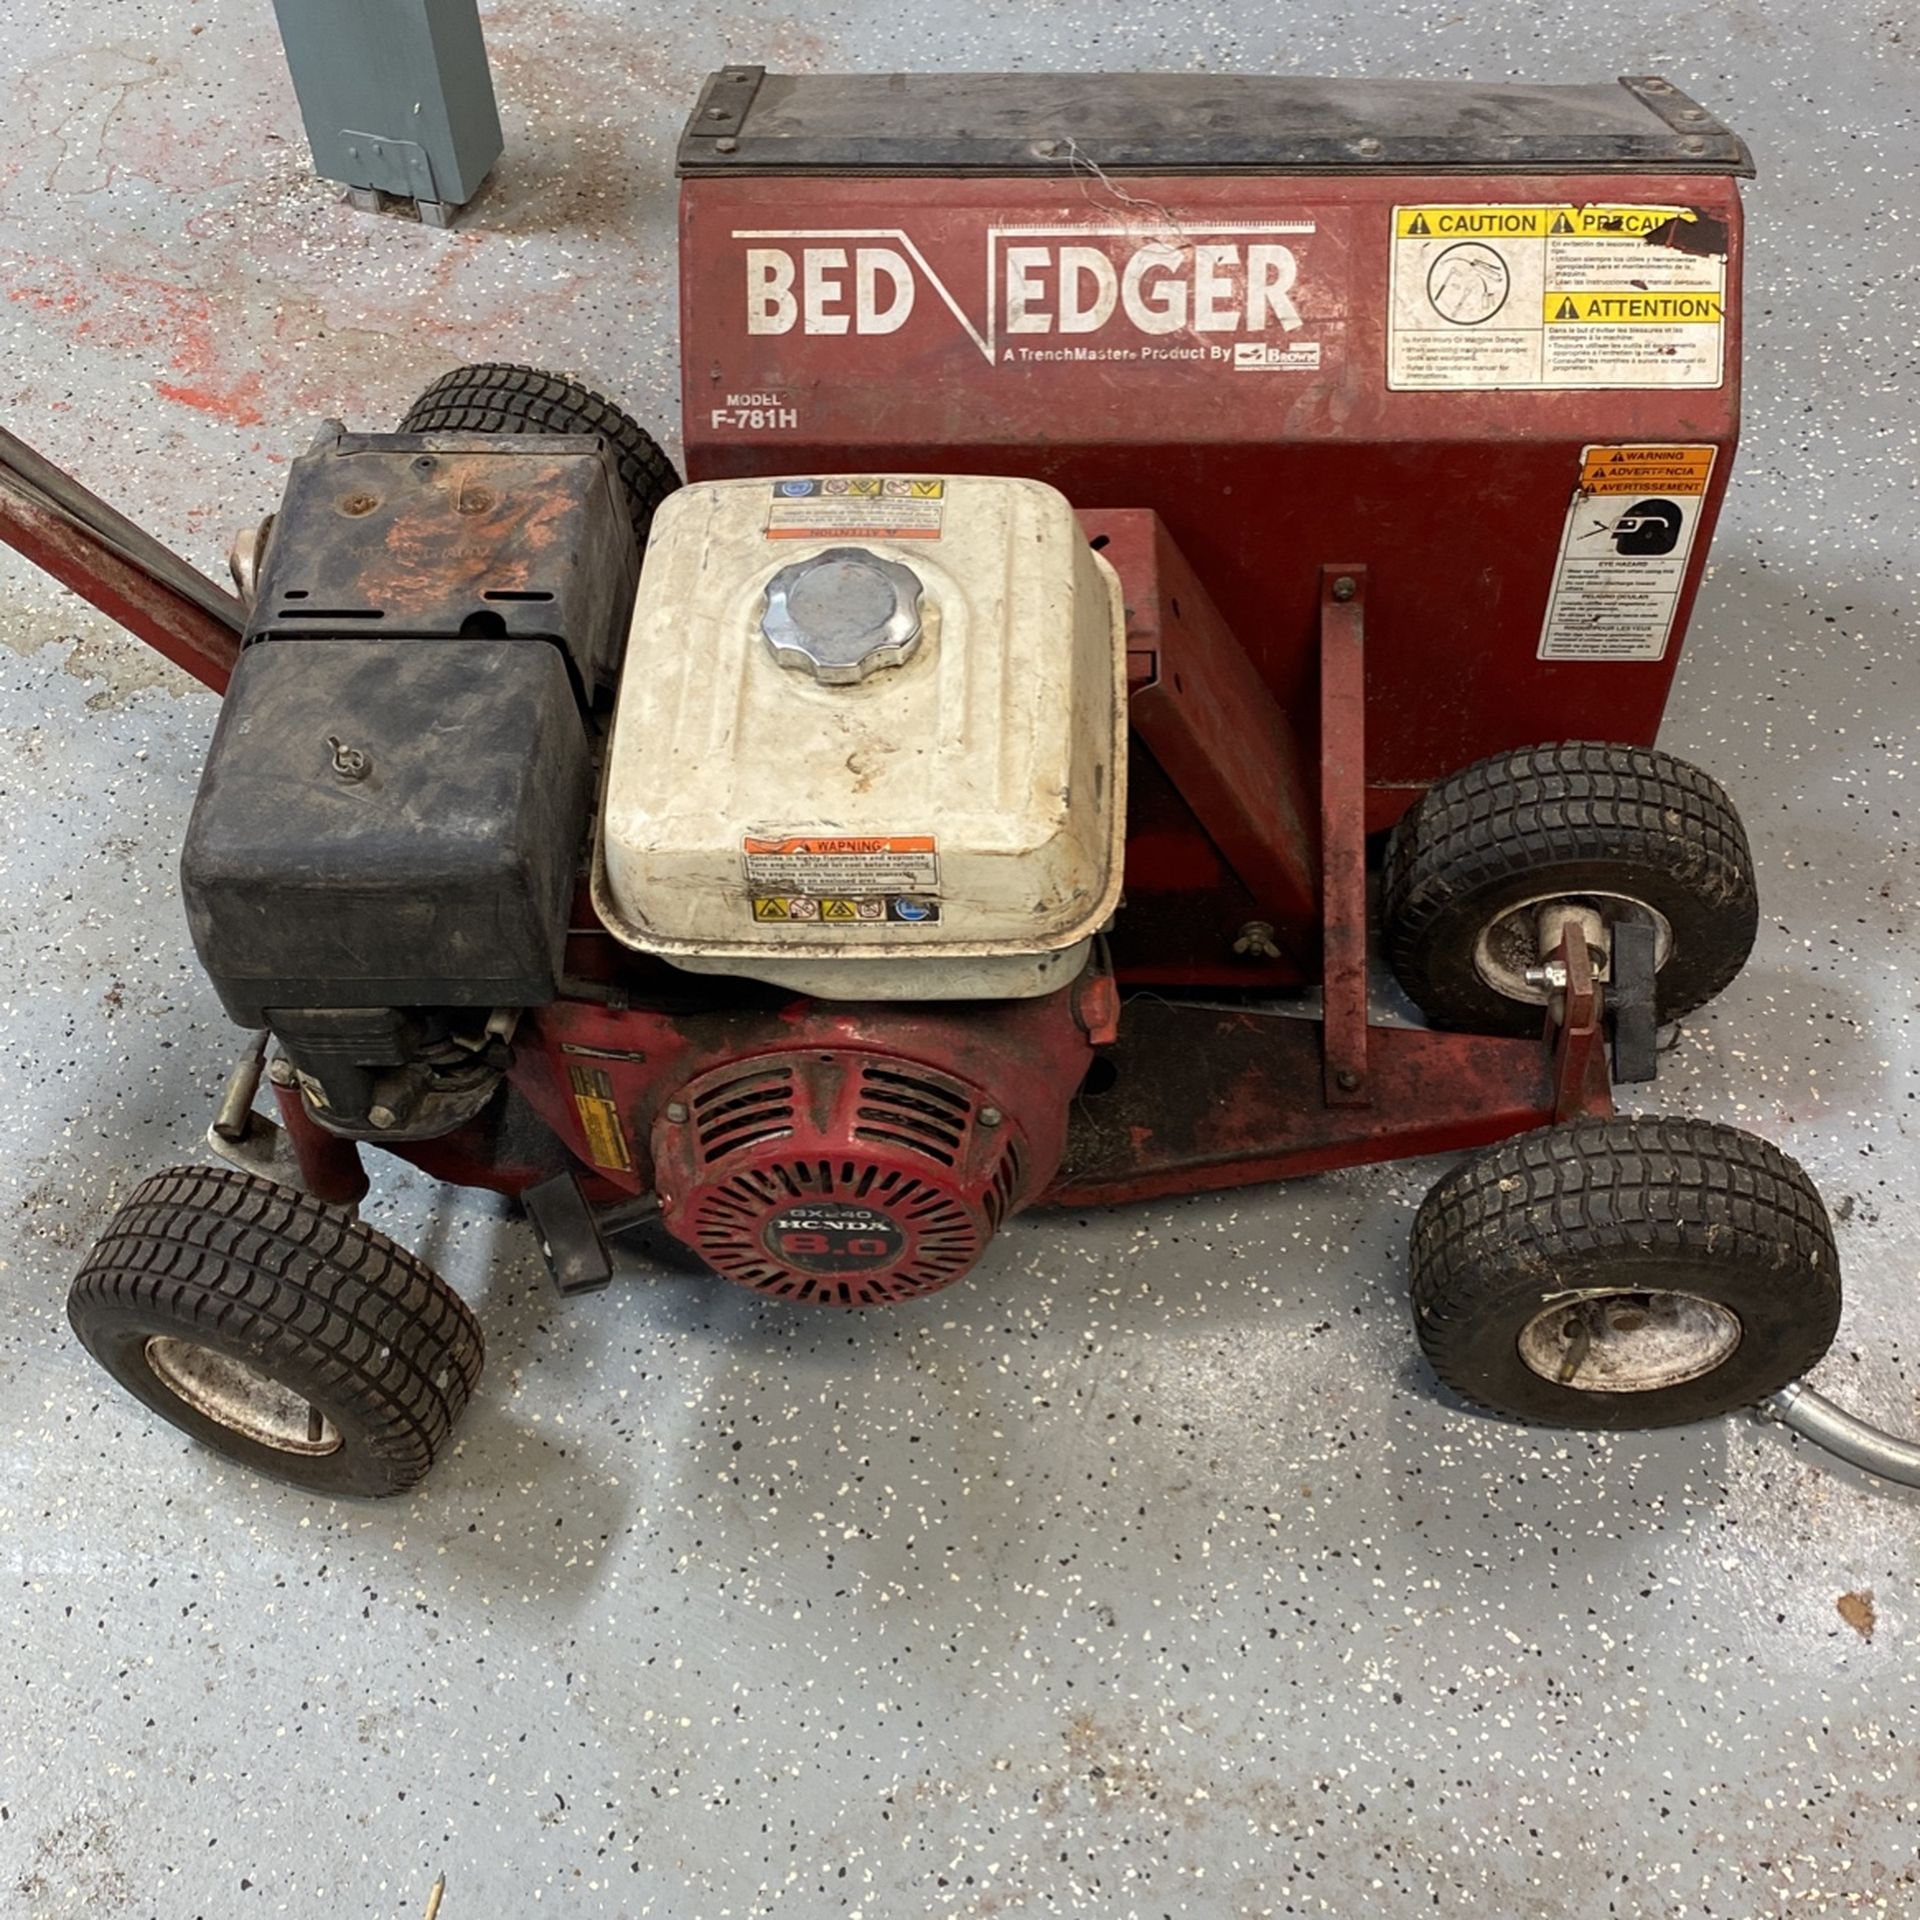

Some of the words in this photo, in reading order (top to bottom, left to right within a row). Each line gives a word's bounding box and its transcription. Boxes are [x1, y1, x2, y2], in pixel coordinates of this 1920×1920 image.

[1439, 215, 1537, 232] CAUTION
[746, 248, 915, 335] BED
[1005, 244, 1304, 335] EDGER
[1587, 299, 1710, 317] ATTENTION
[1003, 348, 1015, 361] A
[1141, 346, 1206, 361] Product
[1211, 346, 1231, 362] By
[727, 394, 781, 406] MODEL
[712, 409, 797, 429] F-781H
[1626, 451, 1684, 461] WARNING
[1600, 482, 1701, 492] AVERTISSEMENT
[816, 840, 881, 851] WARNING
[778, 1220, 891, 1231] HONDA
[782, 1233, 888, 1256] 8.0
